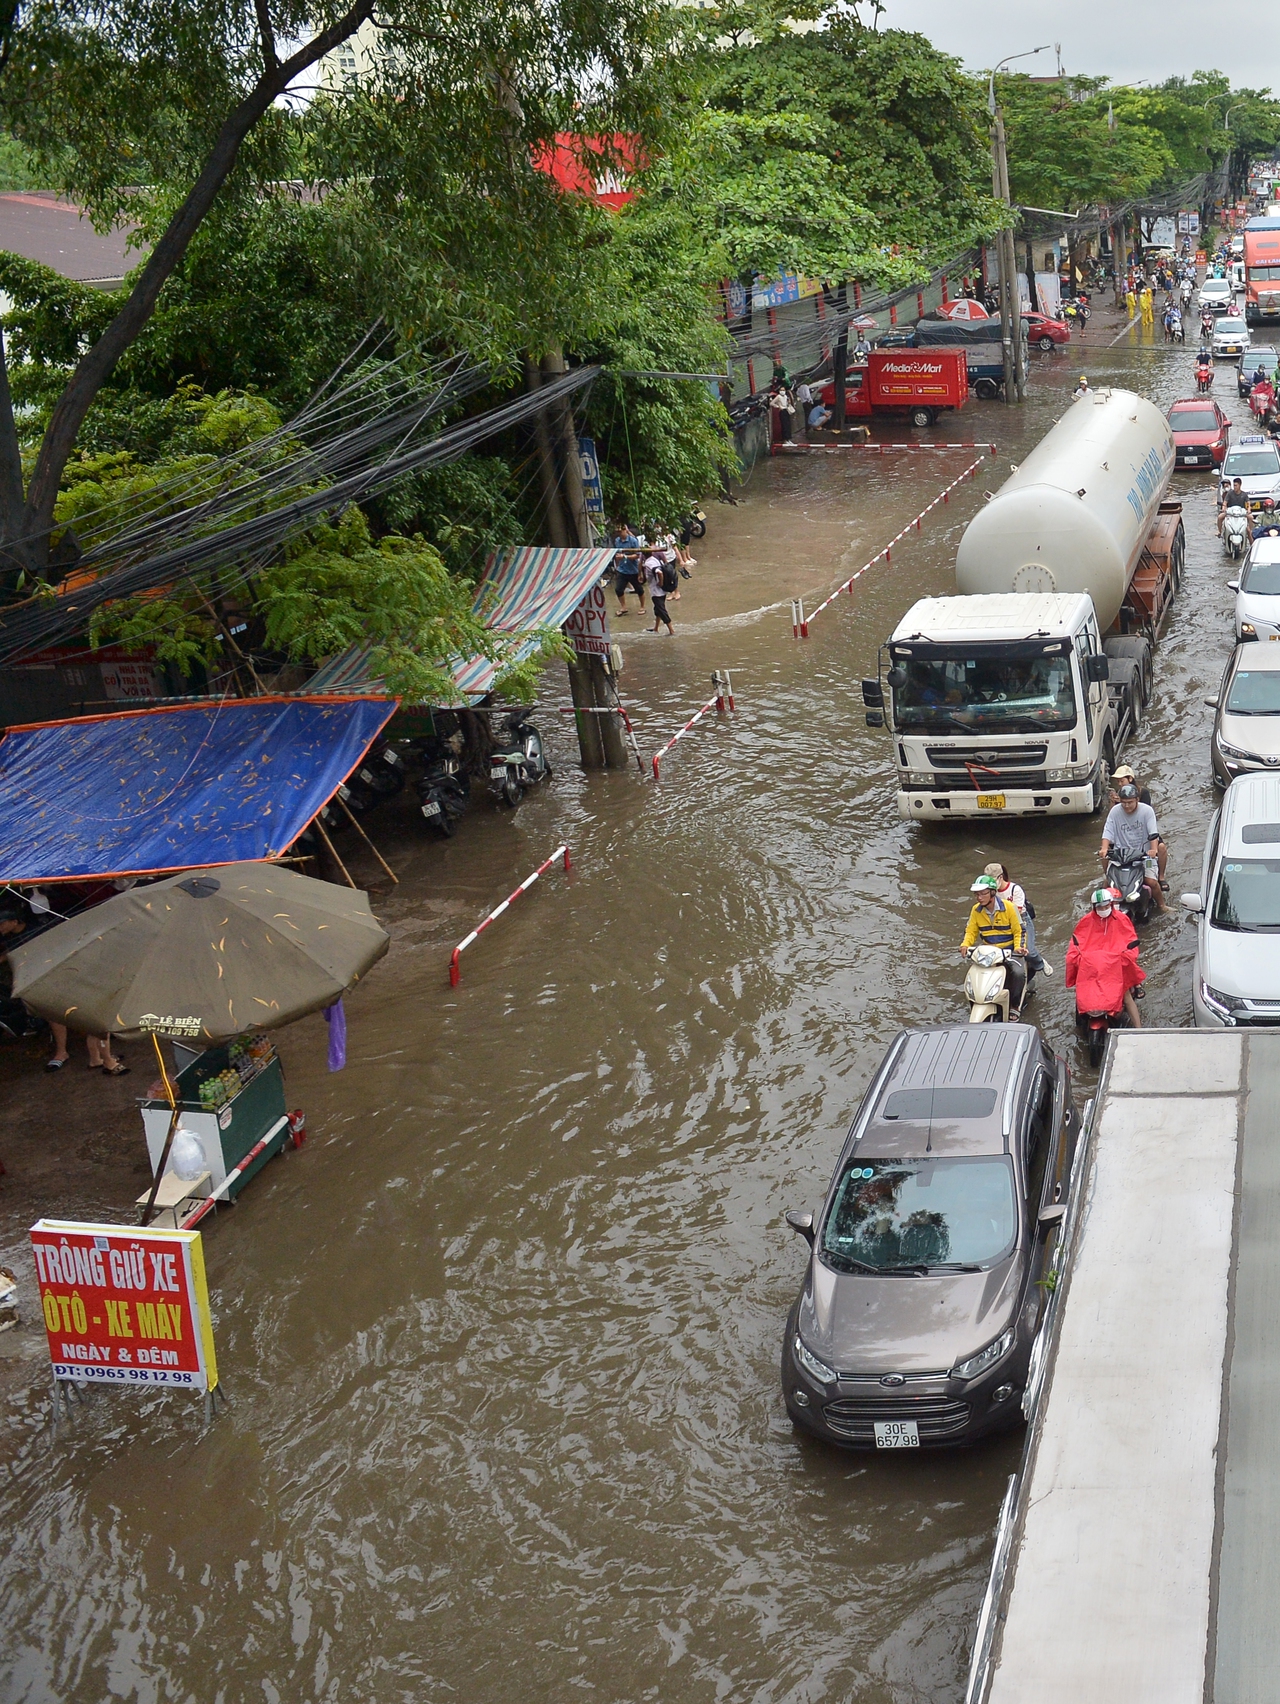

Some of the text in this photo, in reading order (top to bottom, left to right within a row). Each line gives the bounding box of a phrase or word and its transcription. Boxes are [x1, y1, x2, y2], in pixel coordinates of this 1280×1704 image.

[881, 362, 943, 373] Media Mart
[160, 1015, 174, 1024] LÊ
[109, 1243, 147, 1291] GIỮ
[149, 1253, 180, 1292] XE
[42, 1288, 87, 1335] ÔTÔ
[104, 1300, 134, 1338] XE
[136, 1298, 182, 1341] MÁY
[61, 1342, 179, 1365] NGÀY & ĐÊM
[55, 1365, 192, 1383] ĐT: 0965 98 12 98
[884, 1423, 908, 1435] 30E
[877, 1435, 919, 1447] 657.98
